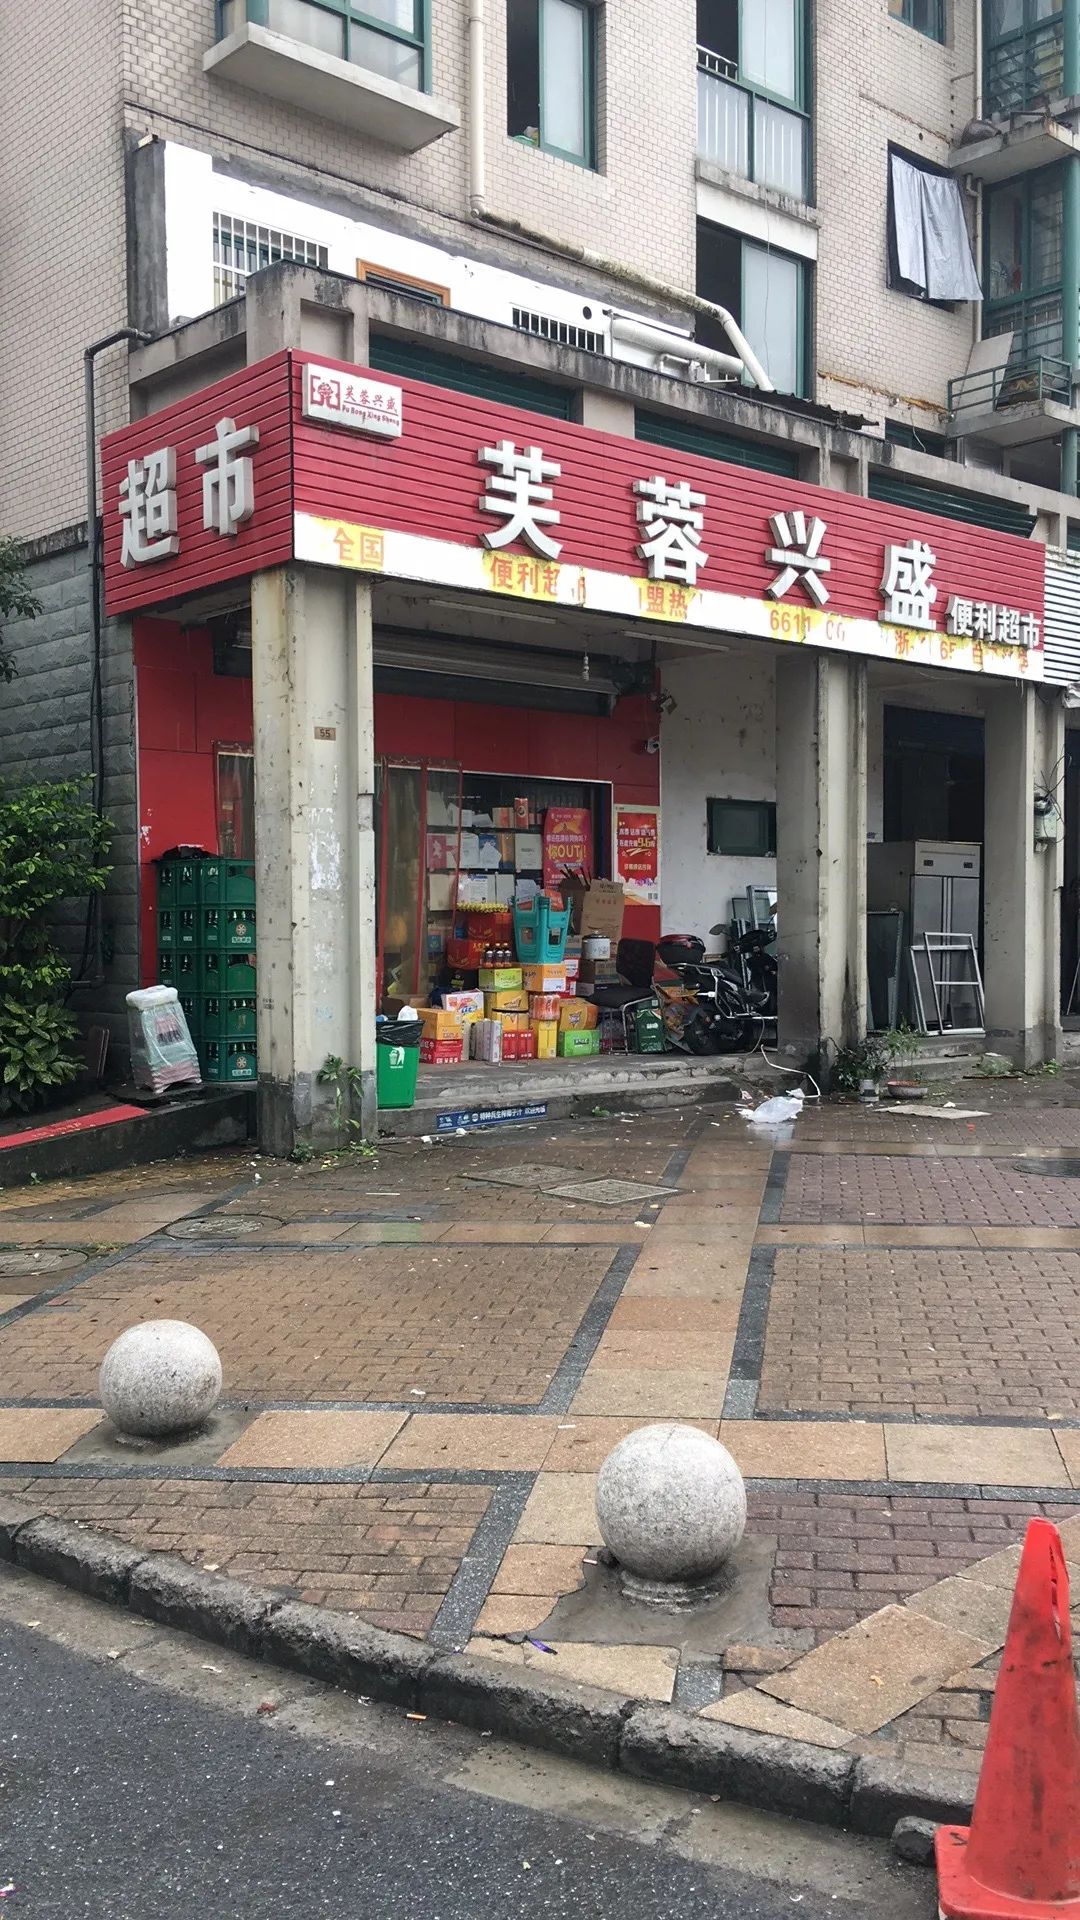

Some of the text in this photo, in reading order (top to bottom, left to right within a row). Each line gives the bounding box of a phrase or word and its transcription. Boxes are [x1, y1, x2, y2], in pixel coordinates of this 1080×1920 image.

[344, 385, 398, 413] 芙蓉兴盛
[367, 411, 381, 421] Xing
[382, 415, 400, 426] Sheng
[118, 417, 260, 569] 超市
[333, 526, 385, 567] 全国
[478, 439, 938, 632] 芙蓉兴盛
[946, 595, 1042, 650] 便利超市
